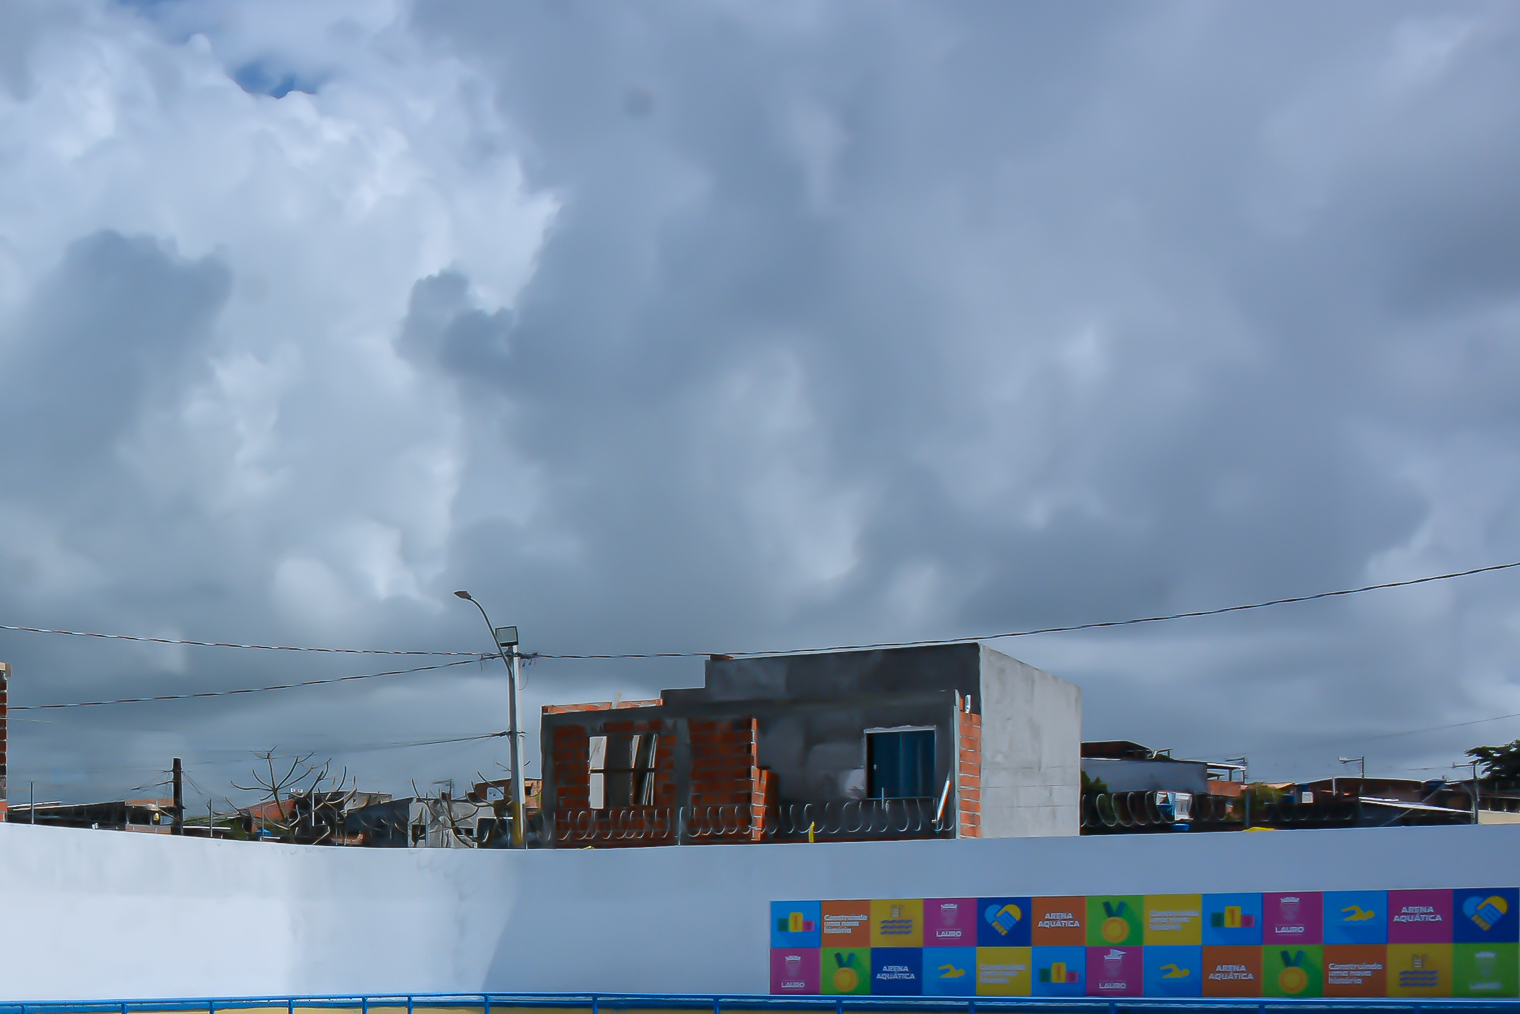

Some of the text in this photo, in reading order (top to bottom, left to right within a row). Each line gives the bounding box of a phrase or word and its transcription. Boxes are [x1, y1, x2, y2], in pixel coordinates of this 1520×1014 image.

[1393, 912, 1442, 923] AQUÁTICA
[1037, 919, 1080, 928] AQUÁTICA
[1215, 964, 1247, 972] ARENA
[875, 972, 916, 981] AQUÁTICA
[1208, 971, 1254, 981] AQUÁTICA
